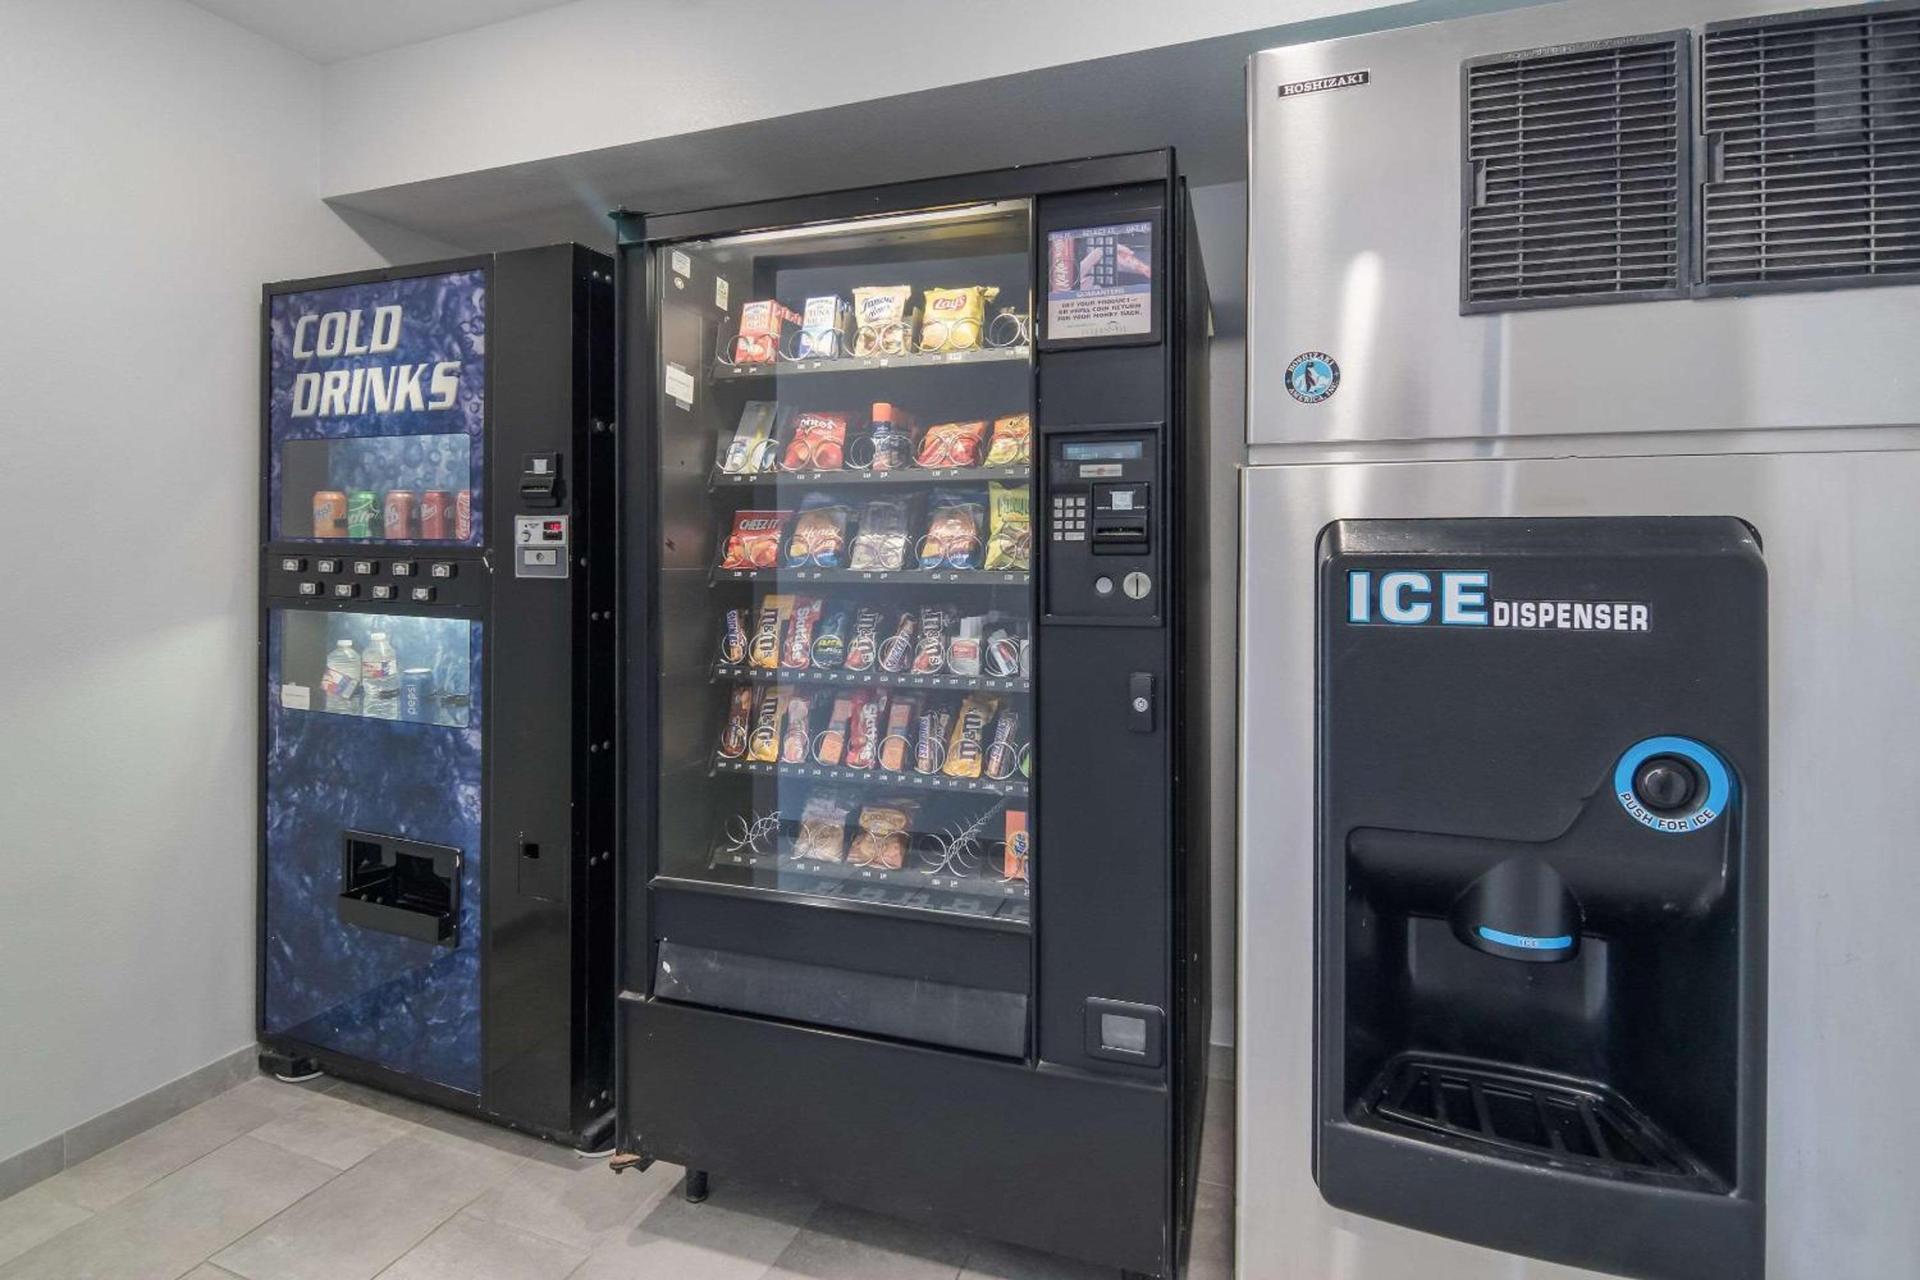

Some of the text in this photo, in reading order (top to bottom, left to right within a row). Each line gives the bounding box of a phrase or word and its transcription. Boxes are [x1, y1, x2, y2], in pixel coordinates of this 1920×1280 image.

[1283, 73, 1365, 95] HOSHIZAKI
[1092, 311, 1118, 319] MONEY
[1111, 303, 1142, 311] RETURN
[292, 304, 403, 360] COLD
[290, 360, 462, 419] DRINKS
[1349, 570, 1649, 631] ICE DISPENSER
[791, 607, 811, 661] Skittles
[406, 684, 418, 716] pepsi
[1620, 792, 1716, 831] PUSH FOR ICE
